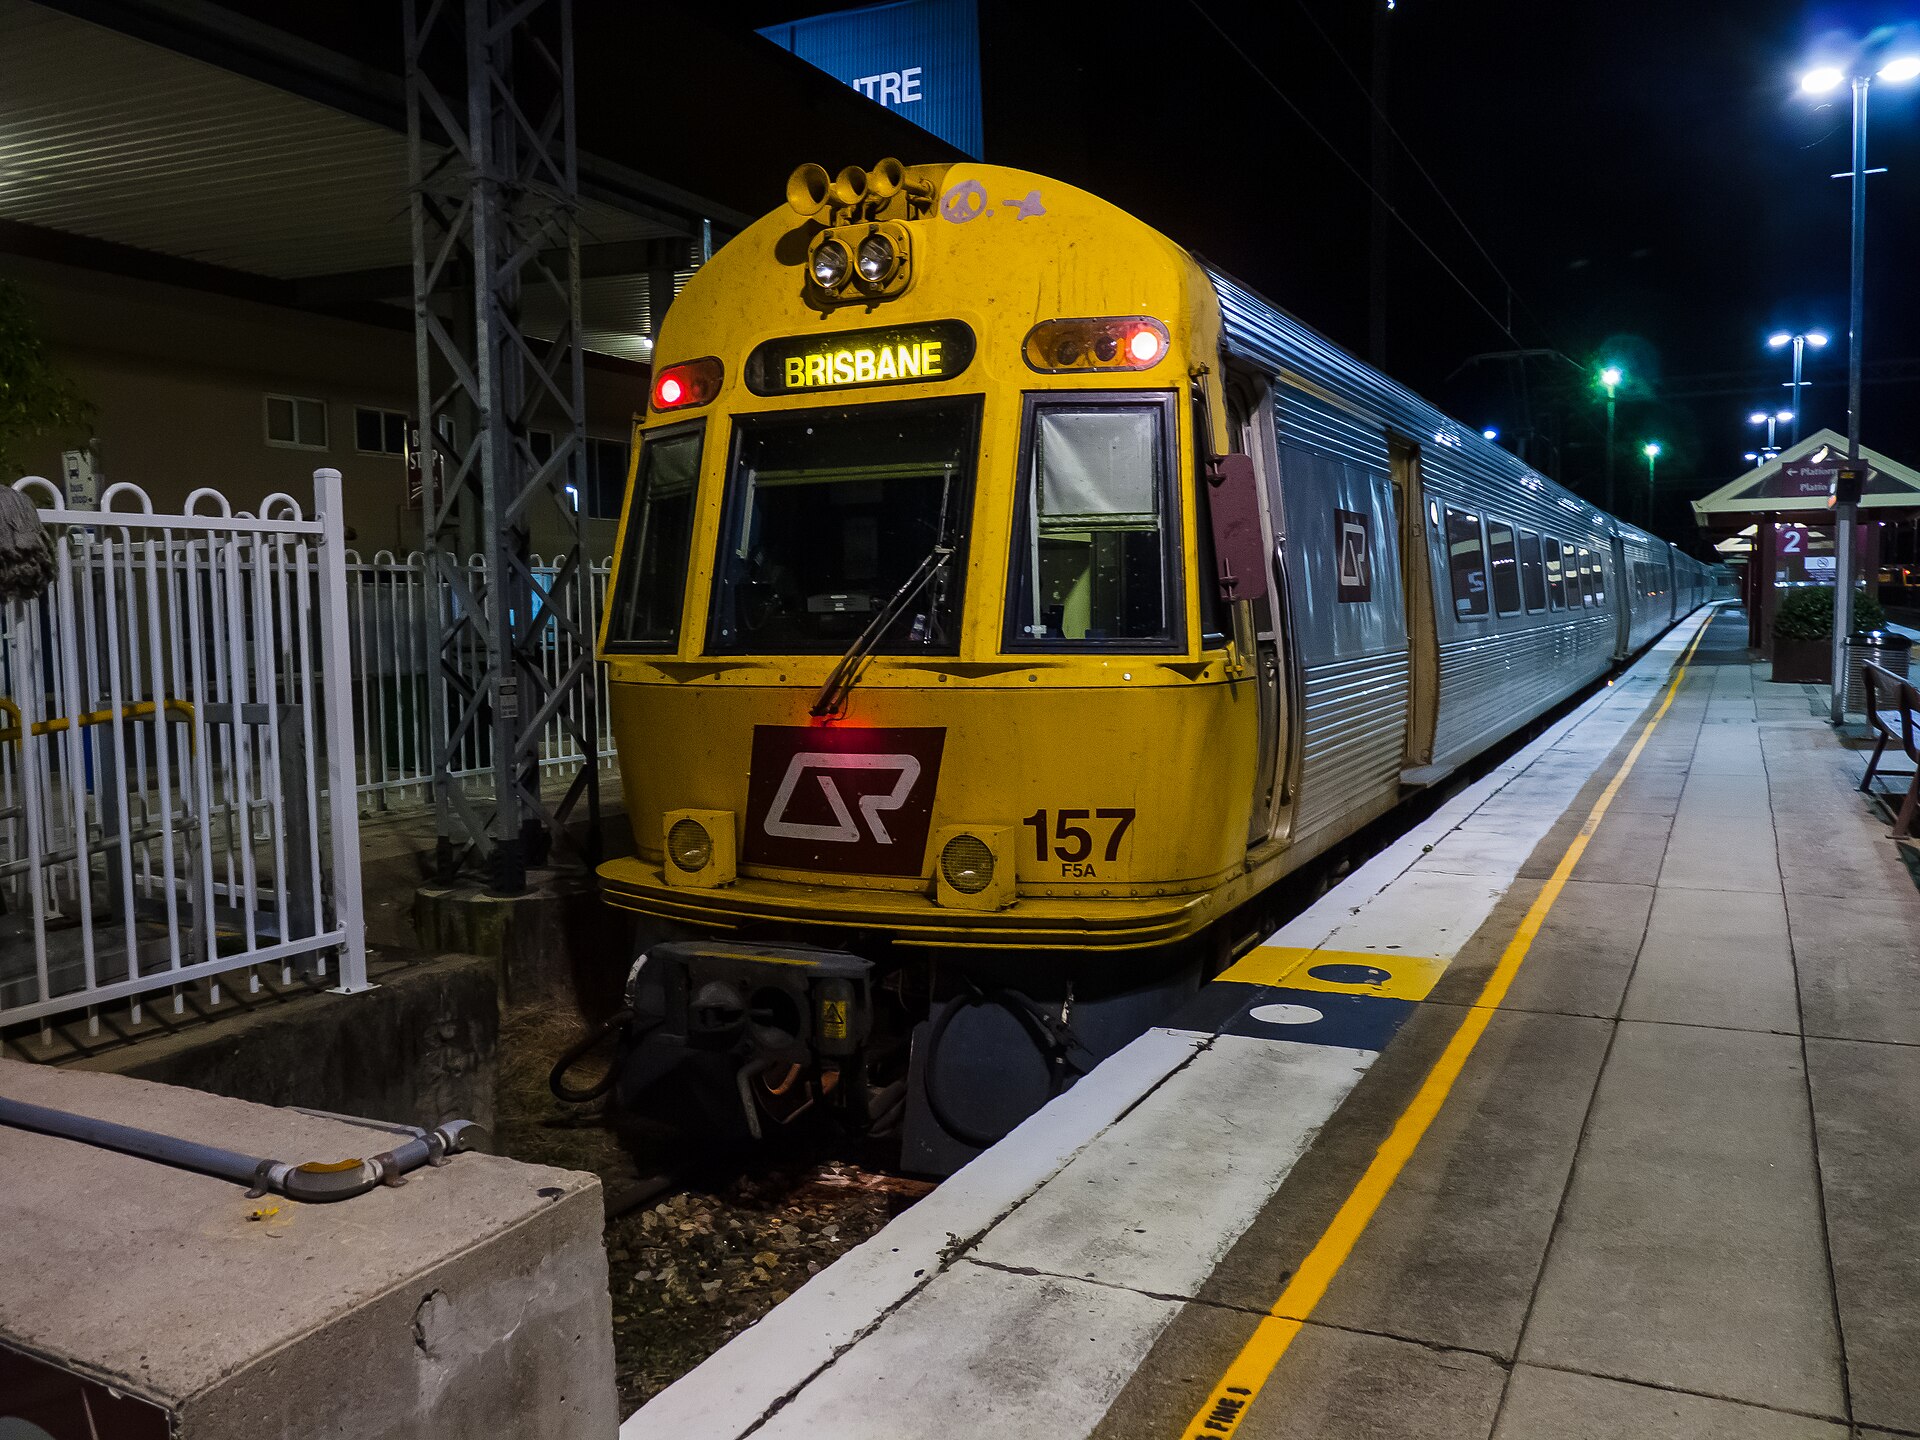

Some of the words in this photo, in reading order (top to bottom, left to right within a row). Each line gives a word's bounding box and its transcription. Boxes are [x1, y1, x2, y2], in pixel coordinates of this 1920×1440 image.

[785, 341, 943, 388] BRISBANE
[409, 448, 438, 470] STP
[1800, 482, 1828, 492] Platfo
[1783, 530, 1801, 553] 2
[1022, 808, 1136, 863] 157
[1061, 863, 1097, 878] F5A
